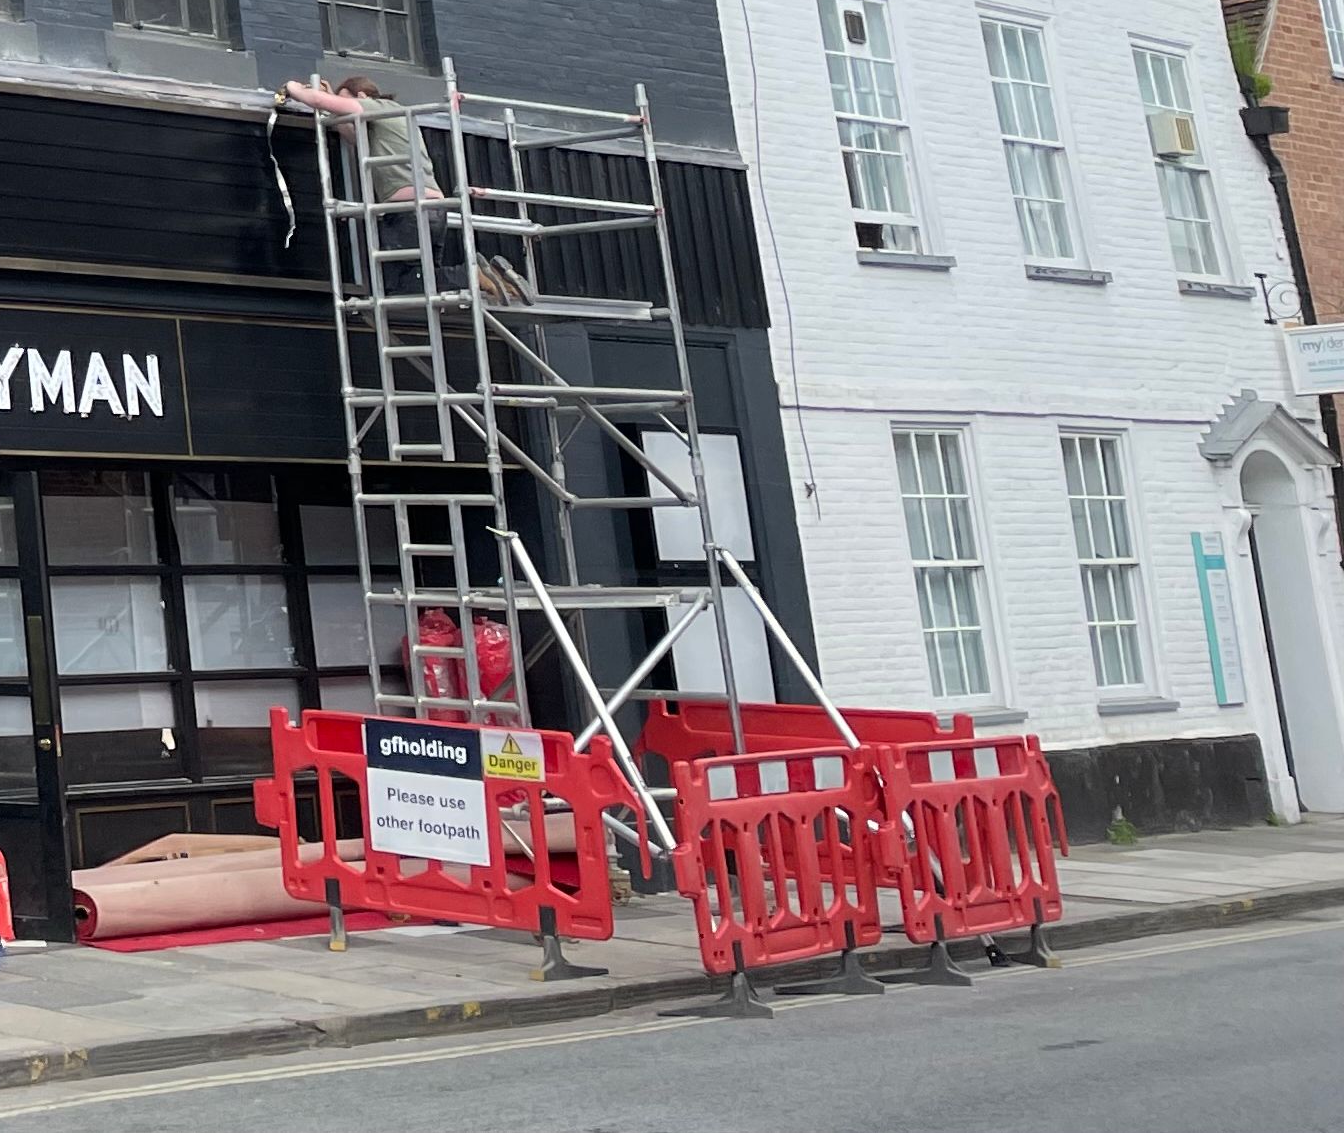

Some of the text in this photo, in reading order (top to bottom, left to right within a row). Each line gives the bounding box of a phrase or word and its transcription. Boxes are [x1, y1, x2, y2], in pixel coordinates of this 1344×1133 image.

[380, 735, 467, 764] gfholding
[488, 754, 537, 773] Danger
[387, 787, 466, 809] Please use
[377, 815, 481, 840] other footpath
